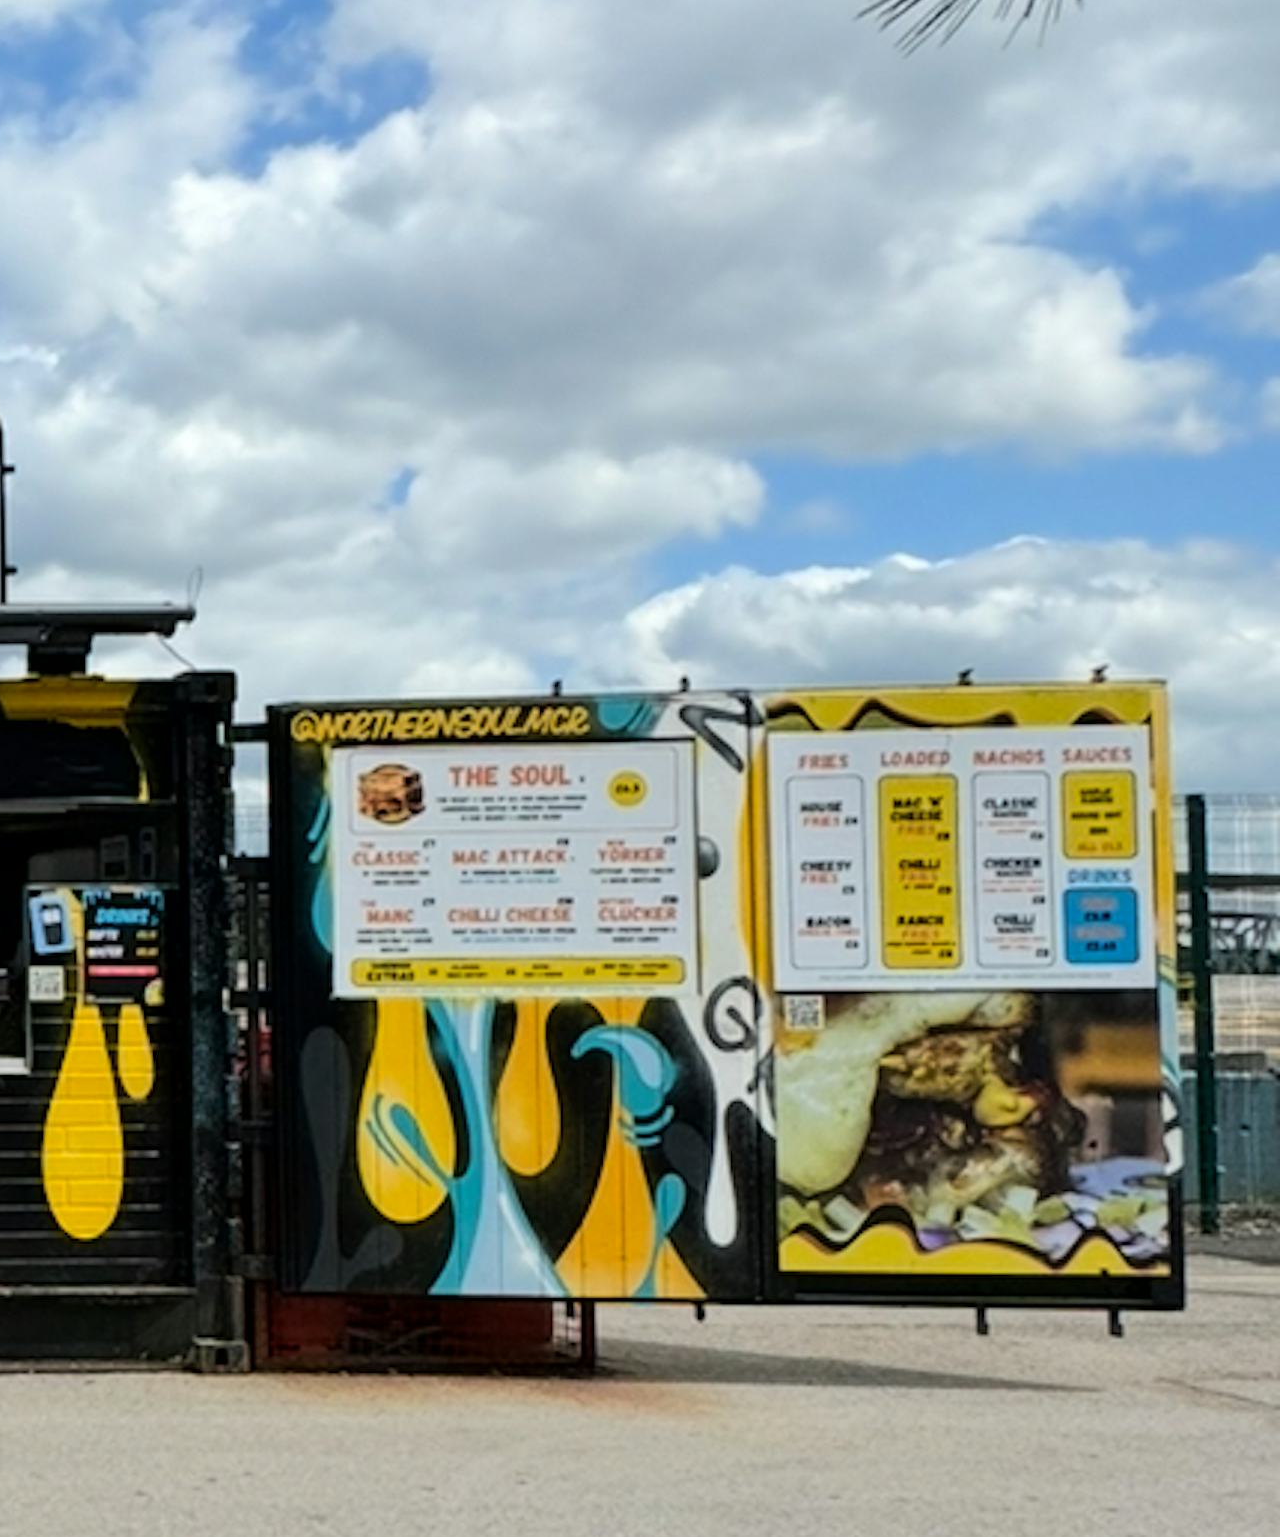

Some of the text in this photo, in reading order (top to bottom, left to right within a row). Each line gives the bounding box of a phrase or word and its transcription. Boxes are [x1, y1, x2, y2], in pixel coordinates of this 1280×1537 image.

[291, 706, 590, 743] @NORTHERNSOULMCR
[880, 751, 950, 767] LOADED
[973, 749, 1045, 765] NACHOS
[1062, 747, 1132, 763] SAUCES
[798, 754, 848, 769] FRIES
[449, 766, 499, 787] THE
[511, 765, 571, 786] SOUL
[800, 801, 842, 812] HOUSE
[893, 798, 921, 809] MAC
[982, 797, 1038, 809] CLASSIC
[803, 816, 839, 827] FRIES
[890, 811, 943, 822] CHEESE
[352, 850, 420, 865] CLASSIC
[452, 850, 567, 863] MAC ATTACK
[597, 848, 666, 861] YORKER
[800, 861, 852, 872] CHEESY
[899, 859, 941, 870] CHILLI
[983, 858, 1042, 869] CHICKEN
[801, 873, 837, 884] FRIES
[1067, 869, 1132, 884] DRINKS
[366, 909, 414, 923] MANC
[448, 907, 571, 922] CHILLI CHEESE
[598, 907, 677, 921] CLUCKER
[806, 916, 852, 927] BACON
[896, 915, 944, 926] RANCH
[993, 915, 1036, 926] CHILLI
[366, 971, 414, 981] EXTRAS
